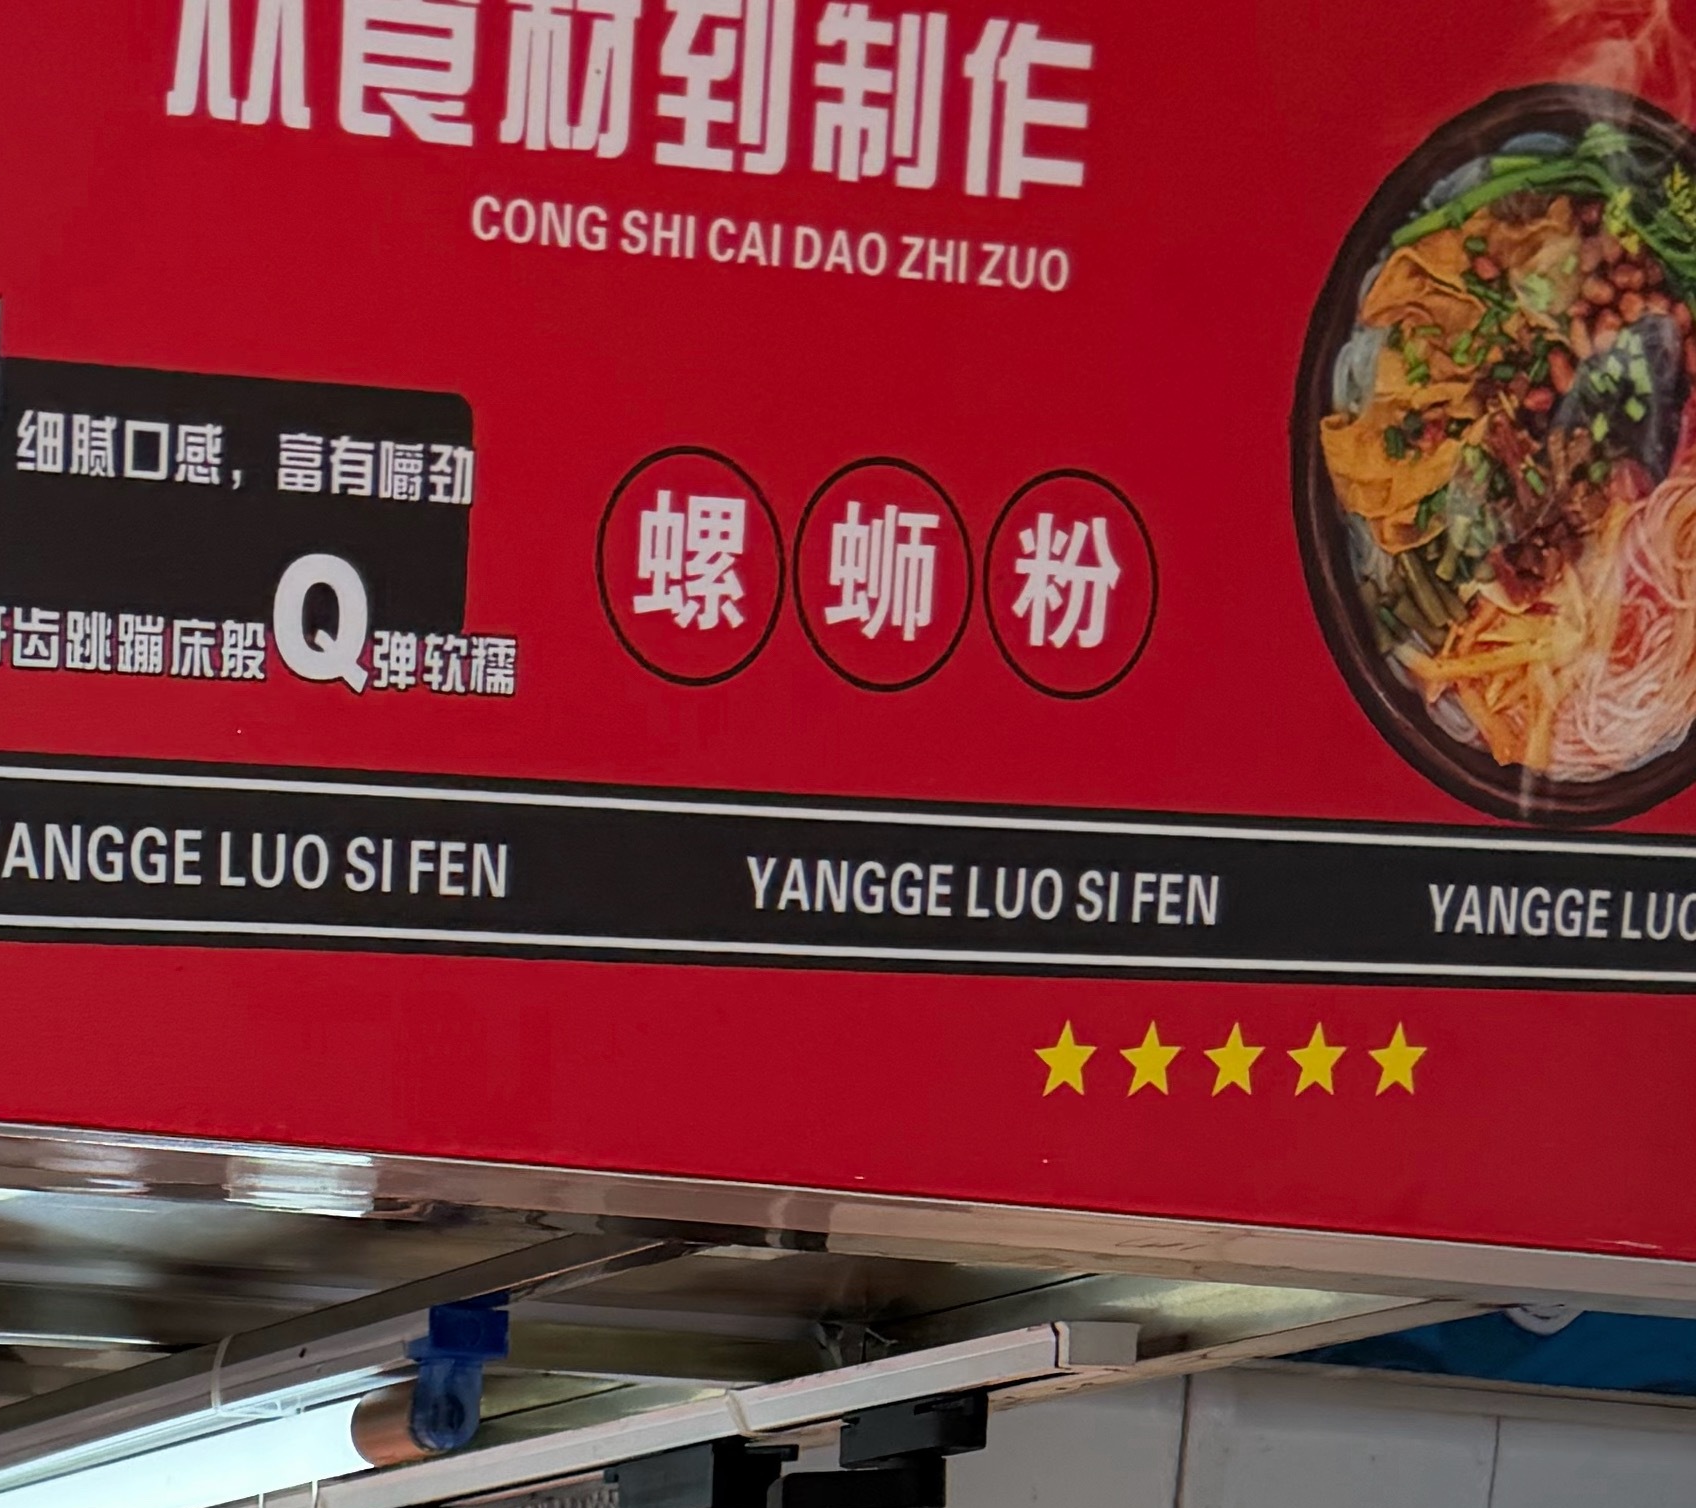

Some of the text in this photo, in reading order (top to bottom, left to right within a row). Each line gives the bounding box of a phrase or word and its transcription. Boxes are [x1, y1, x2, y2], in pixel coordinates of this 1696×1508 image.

[167, 0, 1095, 199] 从食材到制作
[471, 196, 1071, 292] CONG SHI CAI DAO ZHI ZUO
[631, 490, 1122, 649] 螺蛳粉
[748, 855, 952, 919] YANGGE
[1429, 883, 1610, 940] YANGGE
